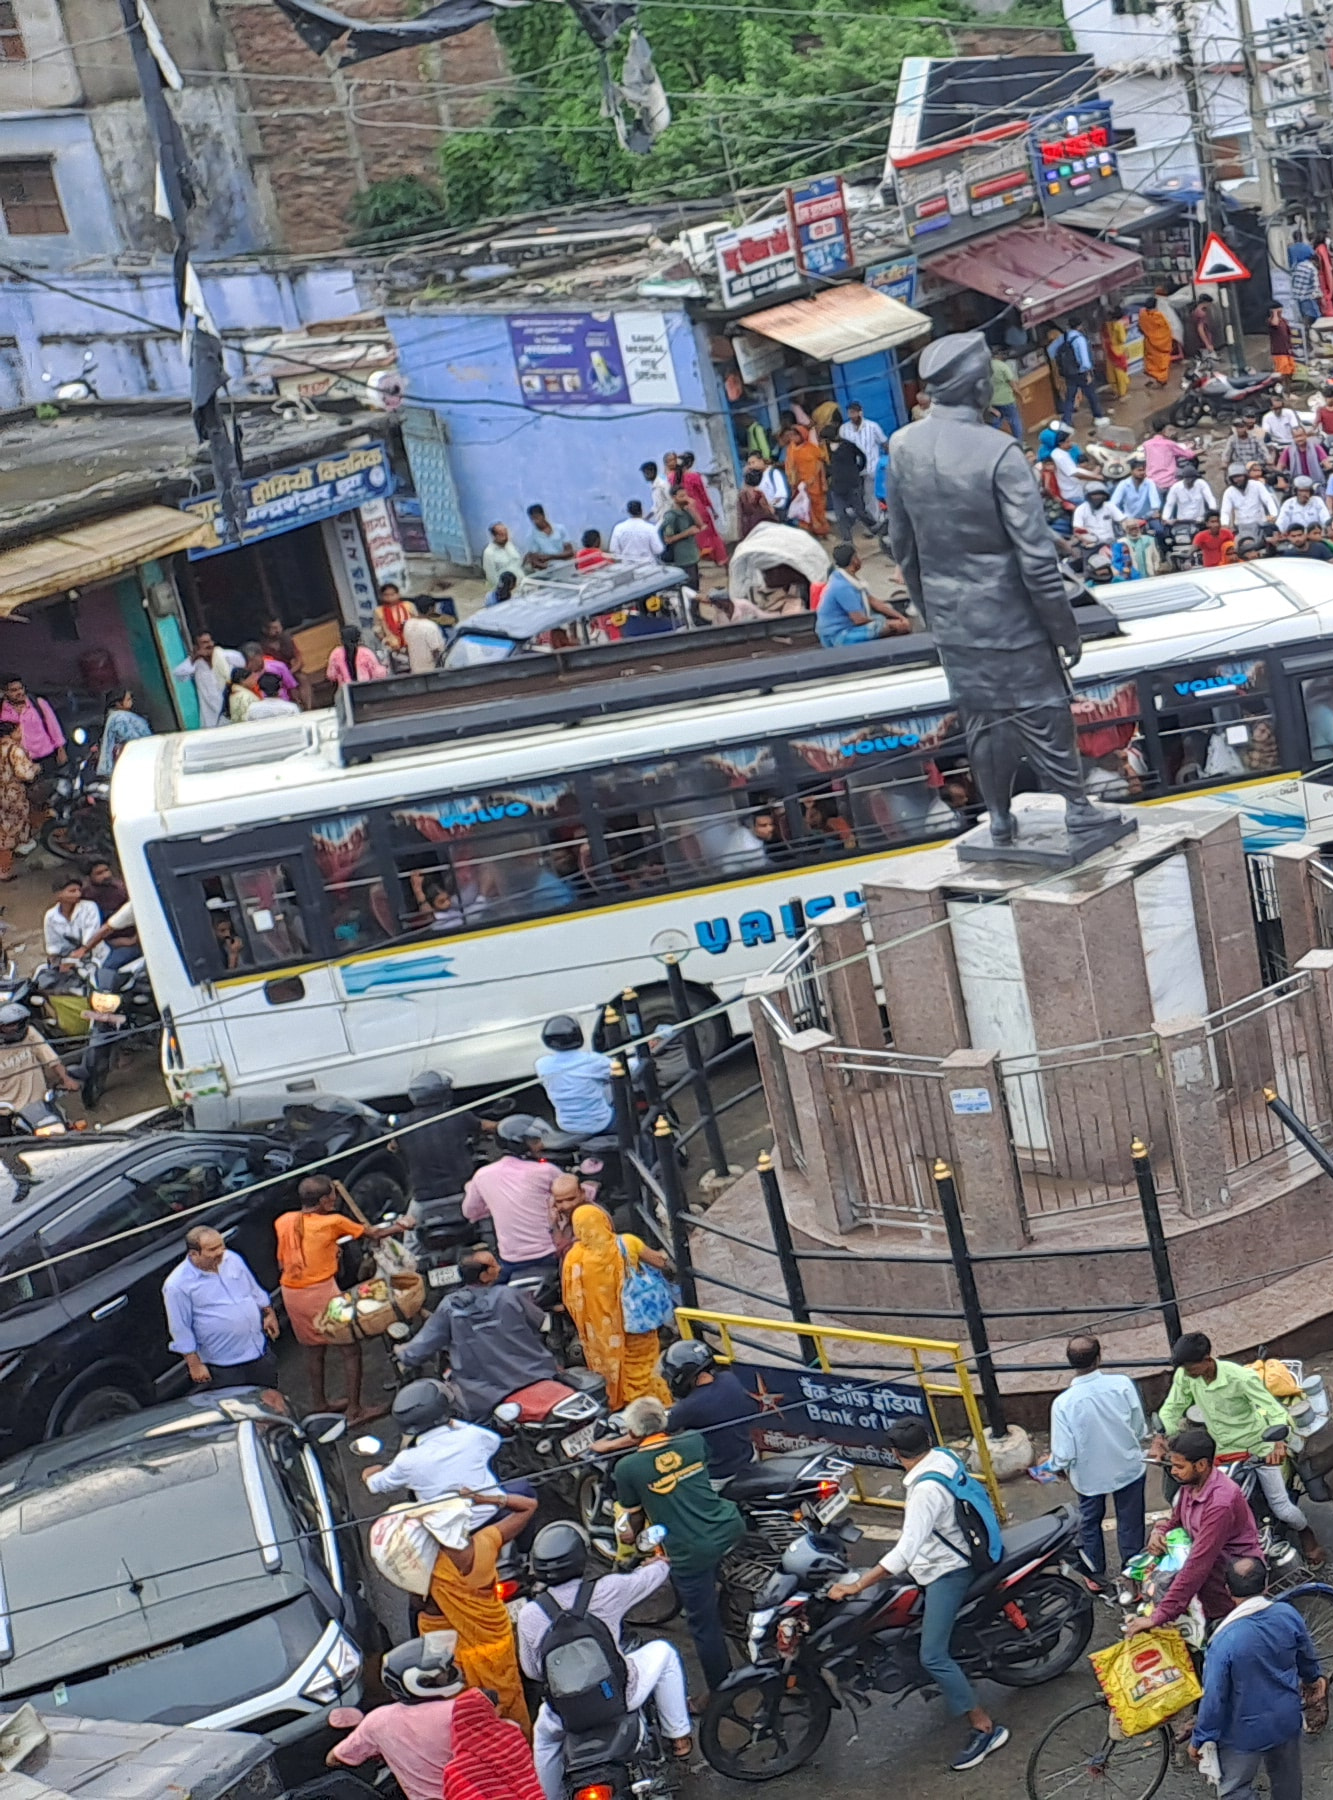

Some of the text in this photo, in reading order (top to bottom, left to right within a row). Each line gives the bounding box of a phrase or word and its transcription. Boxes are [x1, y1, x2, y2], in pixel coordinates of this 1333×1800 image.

[1174, 673, 1249, 696] VOLVO
[840, 733, 919, 758] VOLVO
[438, 801, 530, 830] VOLVO
[870, 1387, 923, 1415] इंडिया
[805, 1403, 855, 1428] Bank
[858, 1412, 878, 1431] of
